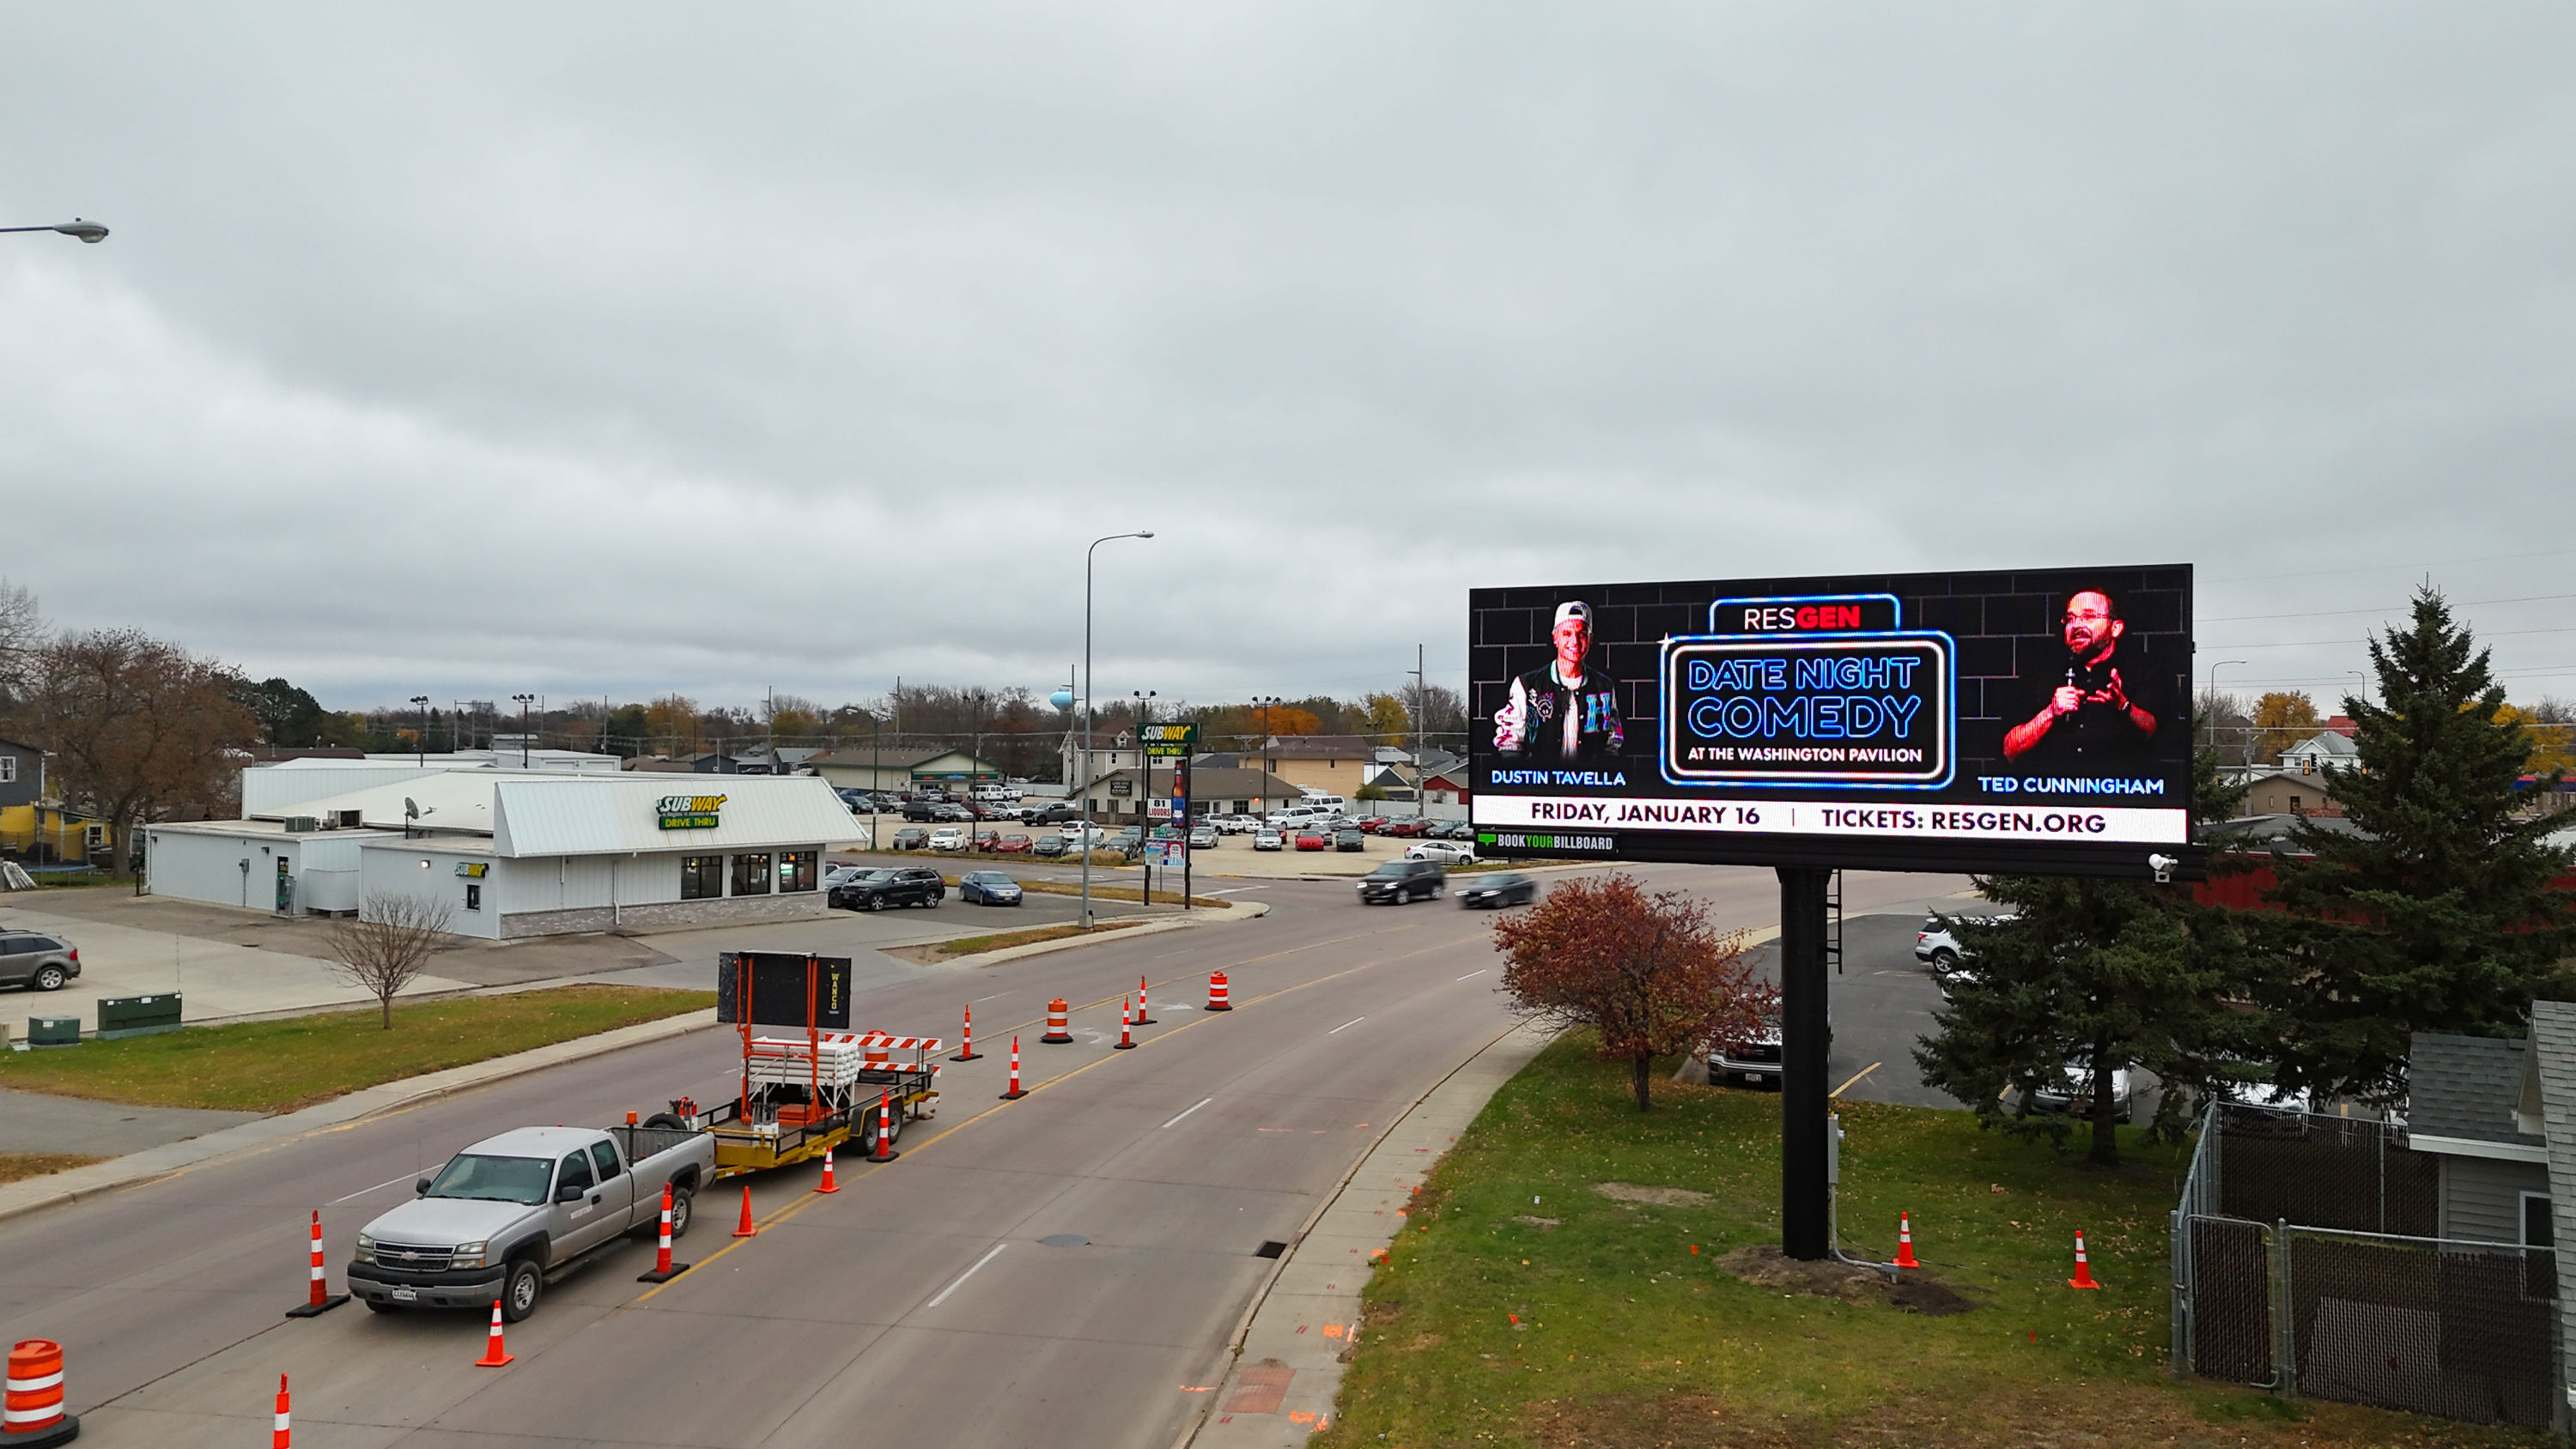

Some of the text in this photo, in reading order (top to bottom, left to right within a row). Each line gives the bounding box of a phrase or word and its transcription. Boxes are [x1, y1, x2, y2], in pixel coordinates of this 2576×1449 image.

[1744, 606, 1861, 630] RESGEN
[1689, 658, 1921, 690] DATE NIGHT
[1688, 695, 1922, 738] COMEDY
[1141, 724, 1192, 741] SUBWAY
[1147, 746, 1182, 755] DRIVE THRU
[1688, 748, 1923, 763] AT THE WASHINGTON PAVILION
[1492, 770, 1626, 786] DUSTIN TAVELLA
[1978, 776, 2164, 795] TED CUNNINGHAM
[656, 795, 727, 812] SUBWAY
[1148, 808, 1170, 816] LIQUORS
[1532, 802, 1760, 825] FRIDAY, JANUARY 16
[1822, 809, 2106, 834] TICKETS: RESGEN.ORG
[665, 817, 715, 828] DRIVE THRU
[1498, 834, 1613, 851] BOOKYOURBILLBOARD
